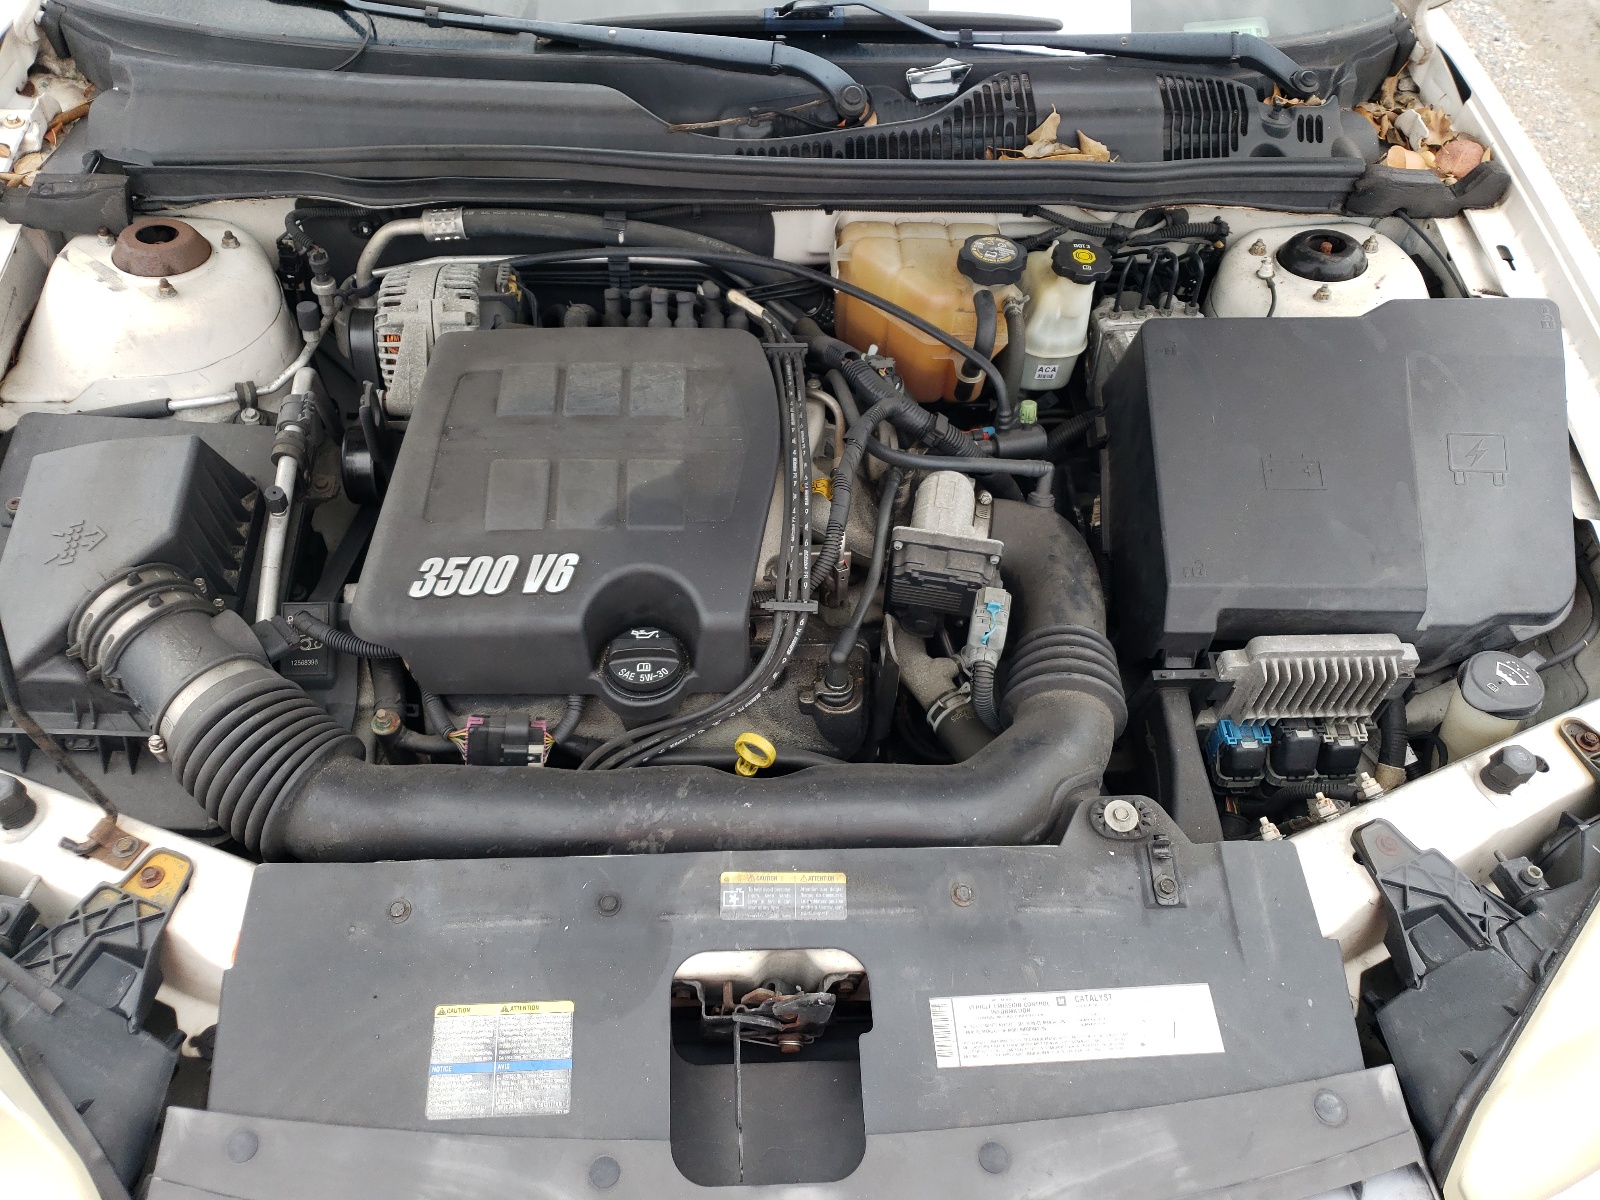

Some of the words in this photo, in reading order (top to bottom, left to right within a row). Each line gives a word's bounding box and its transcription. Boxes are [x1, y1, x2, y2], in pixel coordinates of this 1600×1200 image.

[408, 554, 520, 598] 3500
[522, 552, 580, 594] V6
[618, 668, 636, 681] SAE
[639, 667, 669, 682] 5W-30
[1074, 993, 1113, 1003] CATALYST
[509, 1004, 540, 1012] ATTENTION
[431, 1065, 452, 1073] NOTICE
